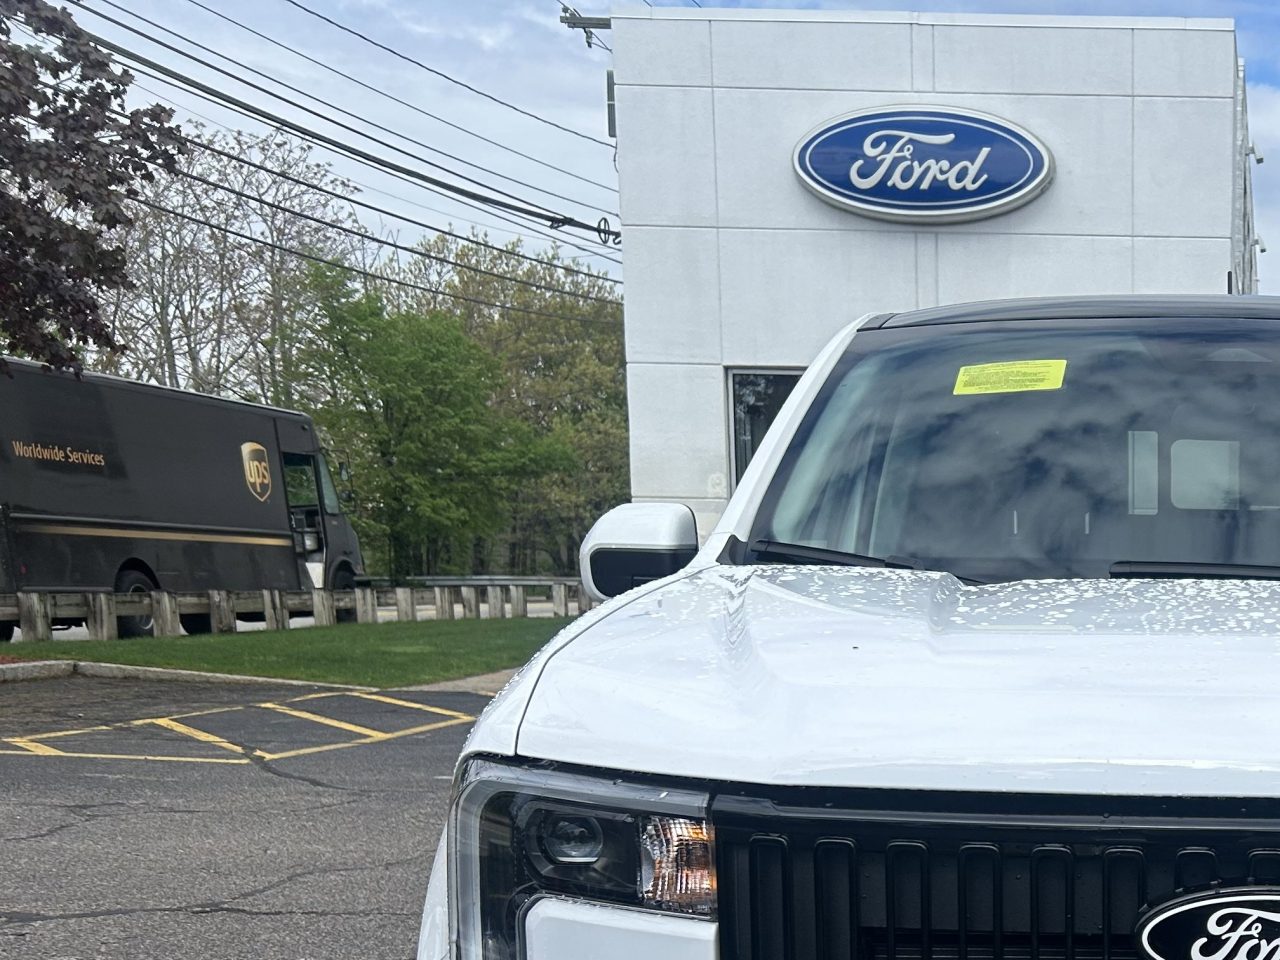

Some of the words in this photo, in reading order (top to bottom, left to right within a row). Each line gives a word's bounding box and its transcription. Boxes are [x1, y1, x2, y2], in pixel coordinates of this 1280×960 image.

[850, 129, 991, 190] Ford
[12, 440, 65, 461] Worldwide
[66, 447, 105, 466] Services
